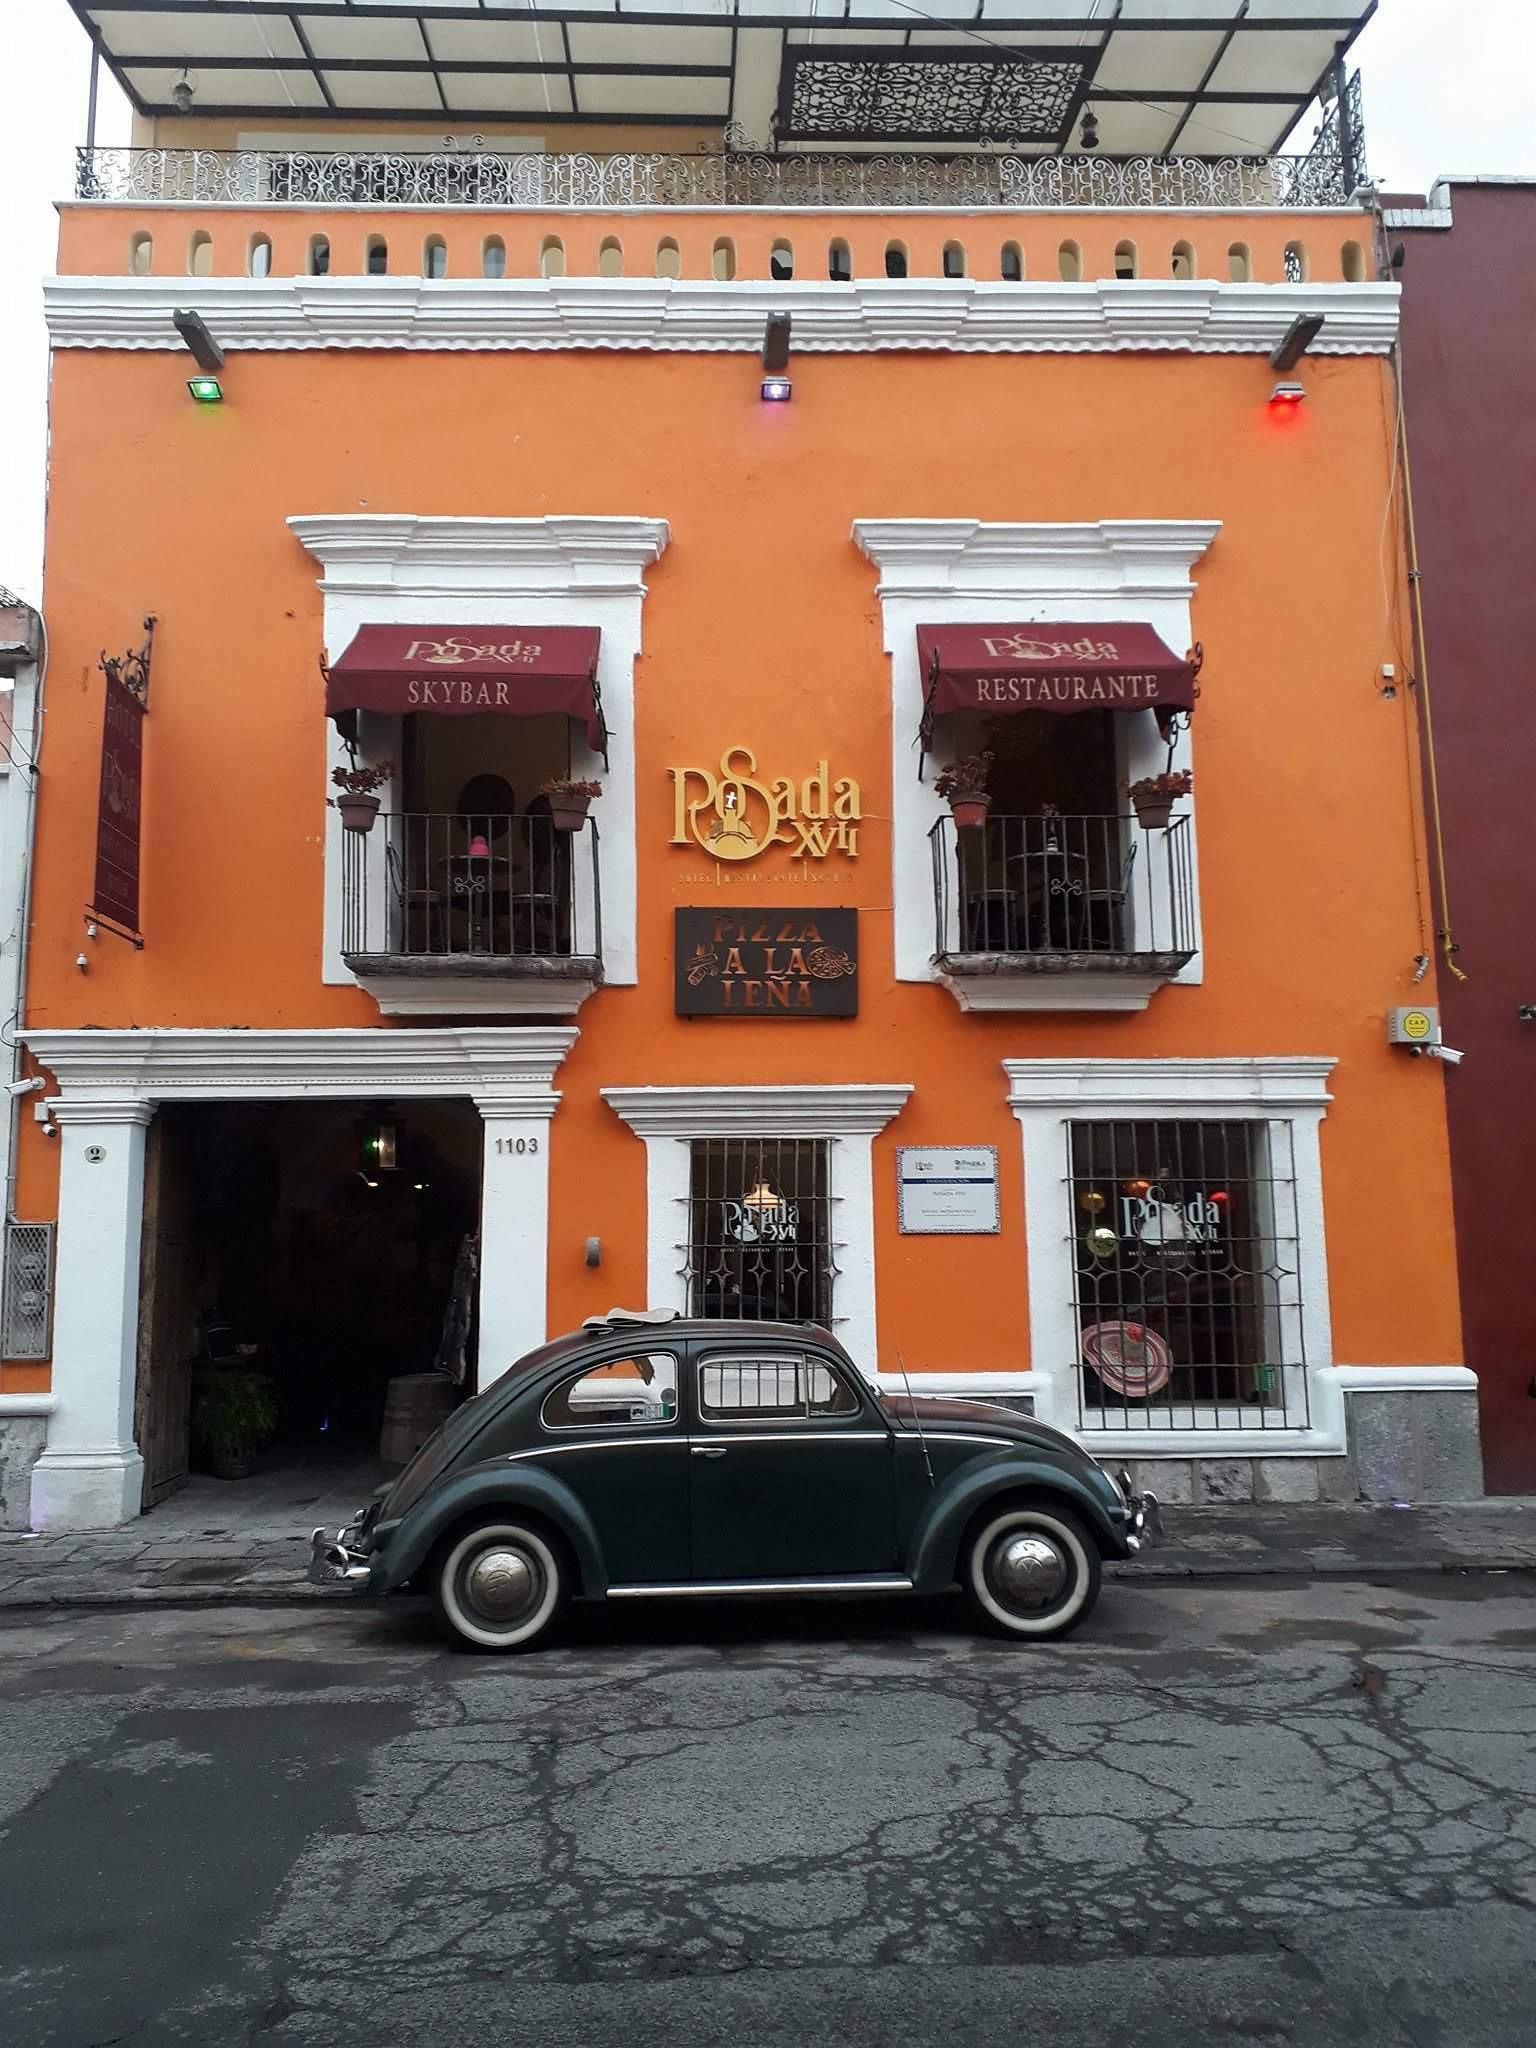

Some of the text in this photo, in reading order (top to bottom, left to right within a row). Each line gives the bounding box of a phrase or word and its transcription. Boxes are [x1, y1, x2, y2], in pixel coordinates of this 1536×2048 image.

[407, 680, 511, 705] SKYBAR
[976, 674, 1160, 702] RESTAURANTE
[790, 821, 862, 858] XVII
[712, 914, 825, 943] PIZZA
[721, 947, 813, 975] A LA
[90, 1147, 100, 1161] 2
[495, 1137, 539, 1154] 1103
